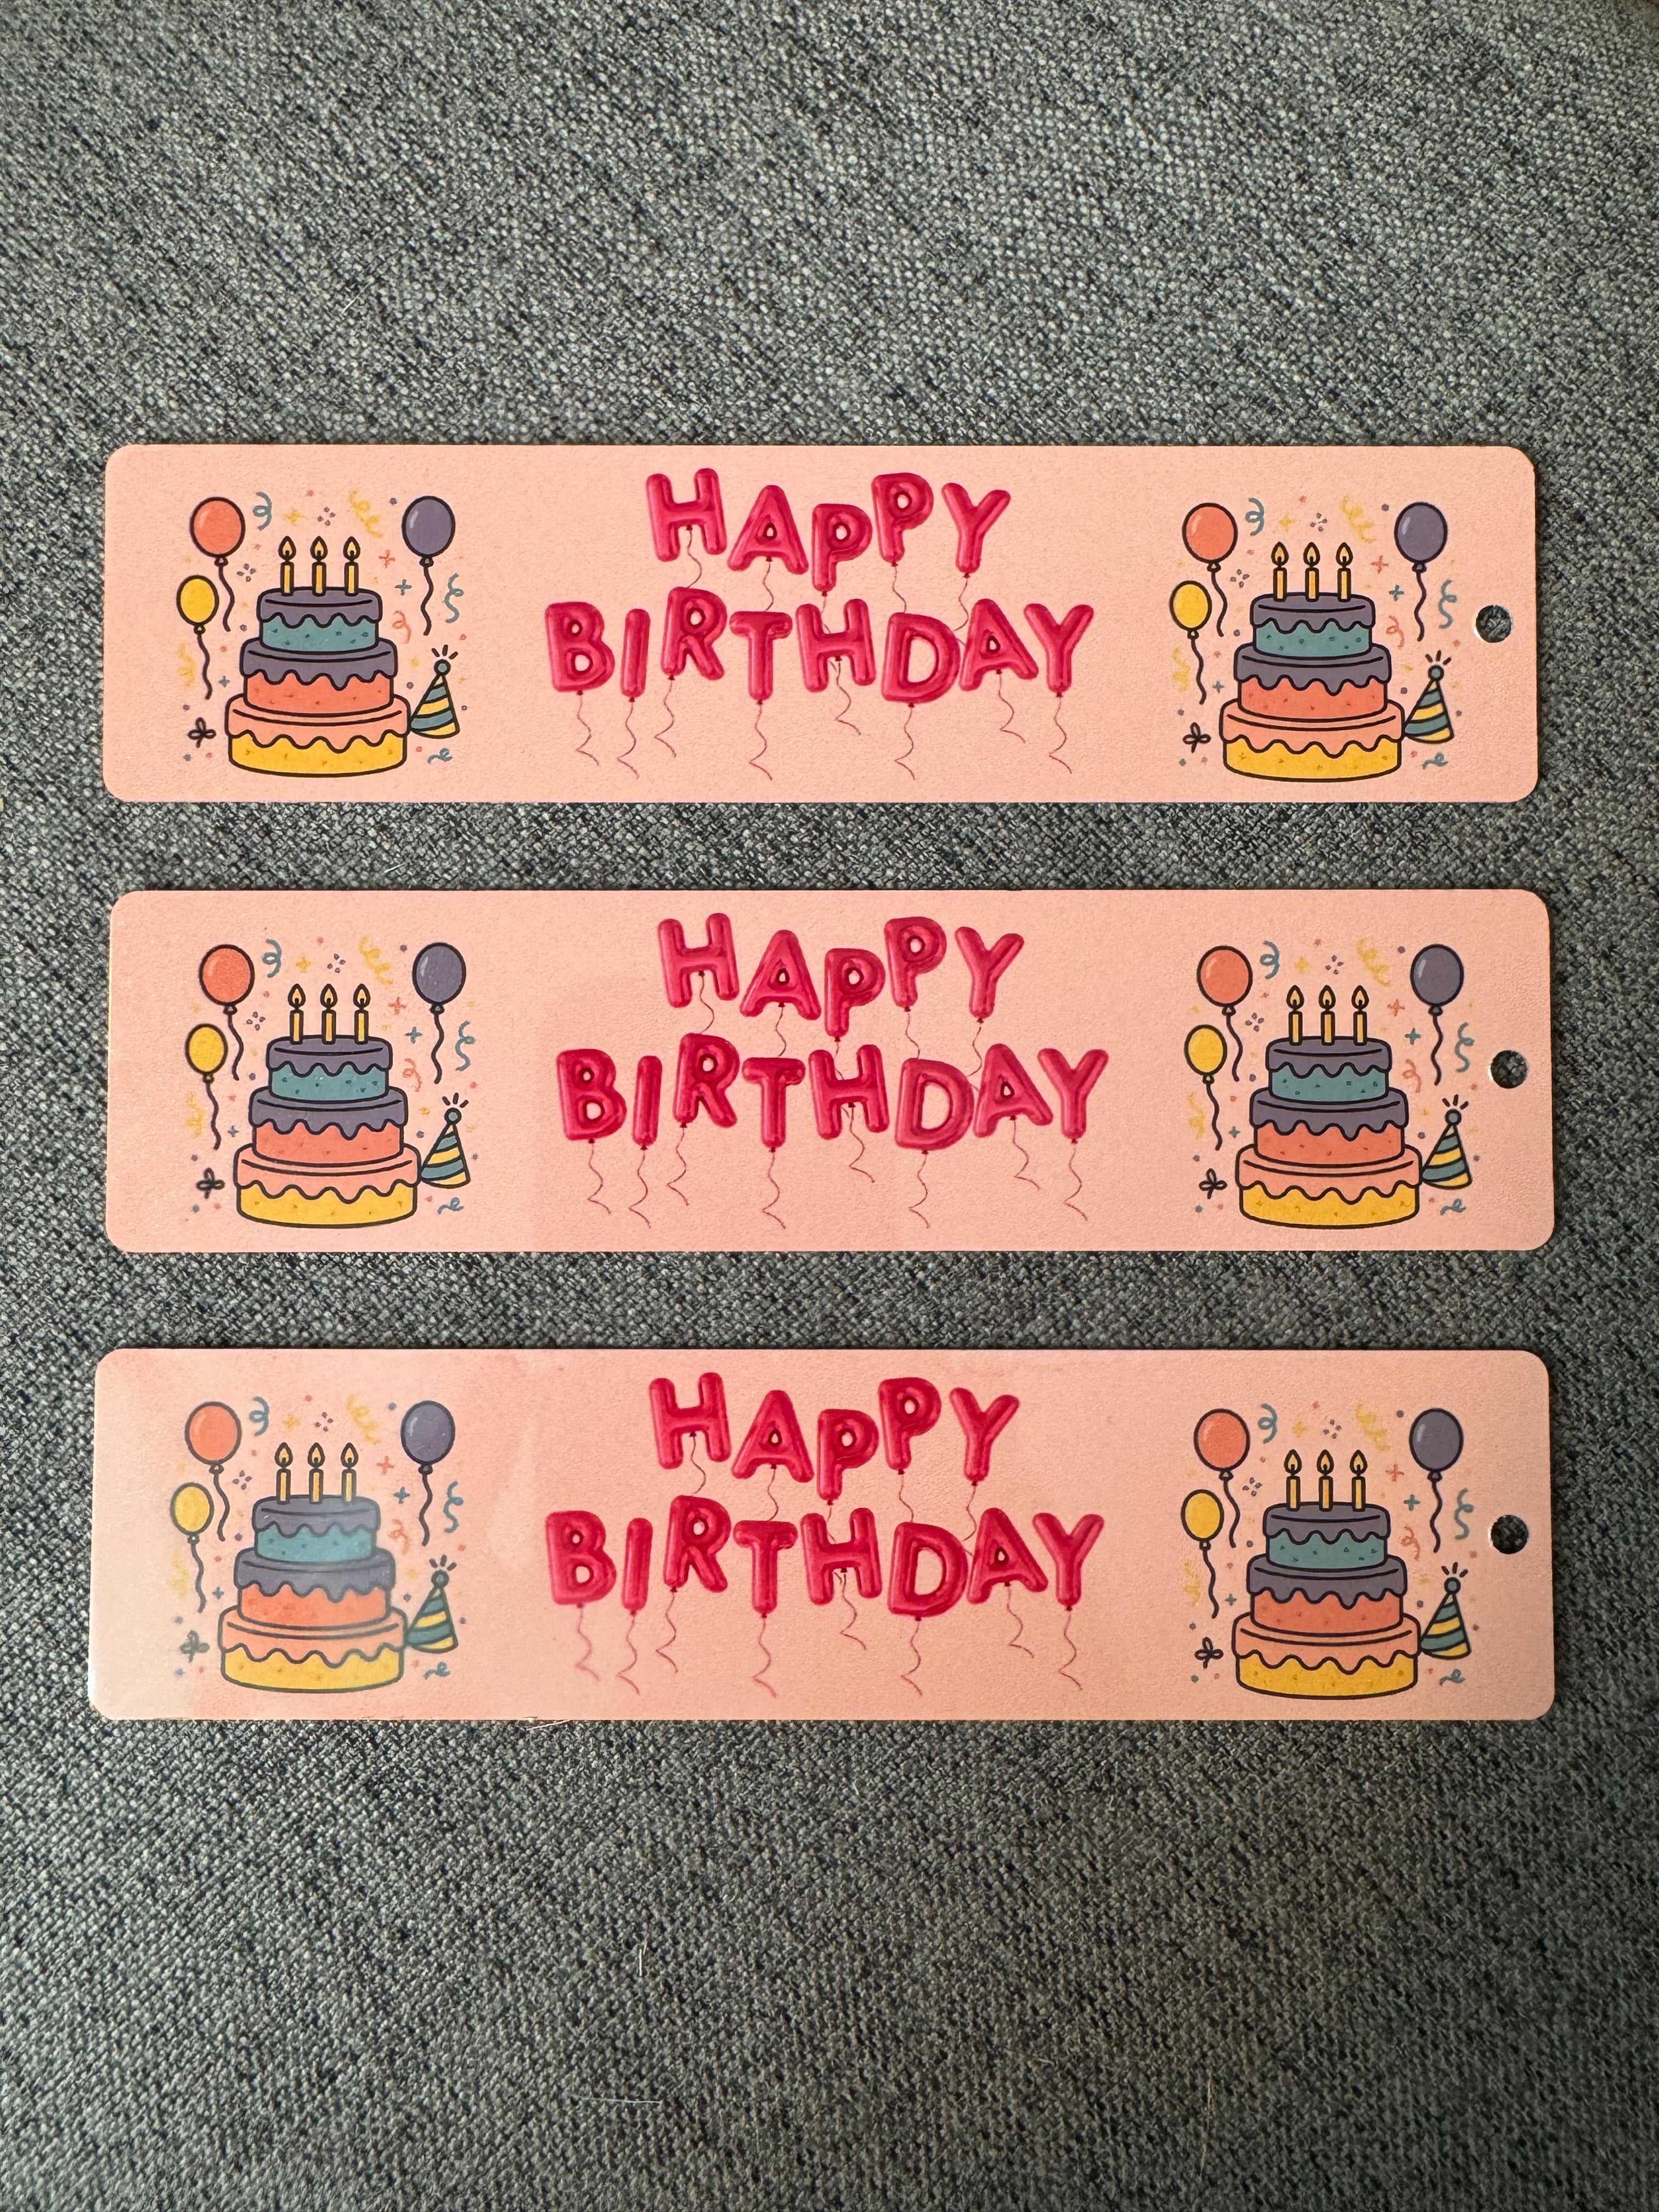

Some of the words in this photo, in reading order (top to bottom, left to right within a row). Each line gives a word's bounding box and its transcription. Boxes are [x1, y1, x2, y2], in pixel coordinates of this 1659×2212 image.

[645, 467, 1012, 597] HAPPY
[545, 586, 1094, 708] BIRTHDAY
[658, 912, 1024, 1043] HAPPY
[556, 1033, 1109, 1155] BIRTHDAY
[648, 1372, 1019, 1506] HAPPY
[545, 1495, 1104, 1622] BIRTHDAY
